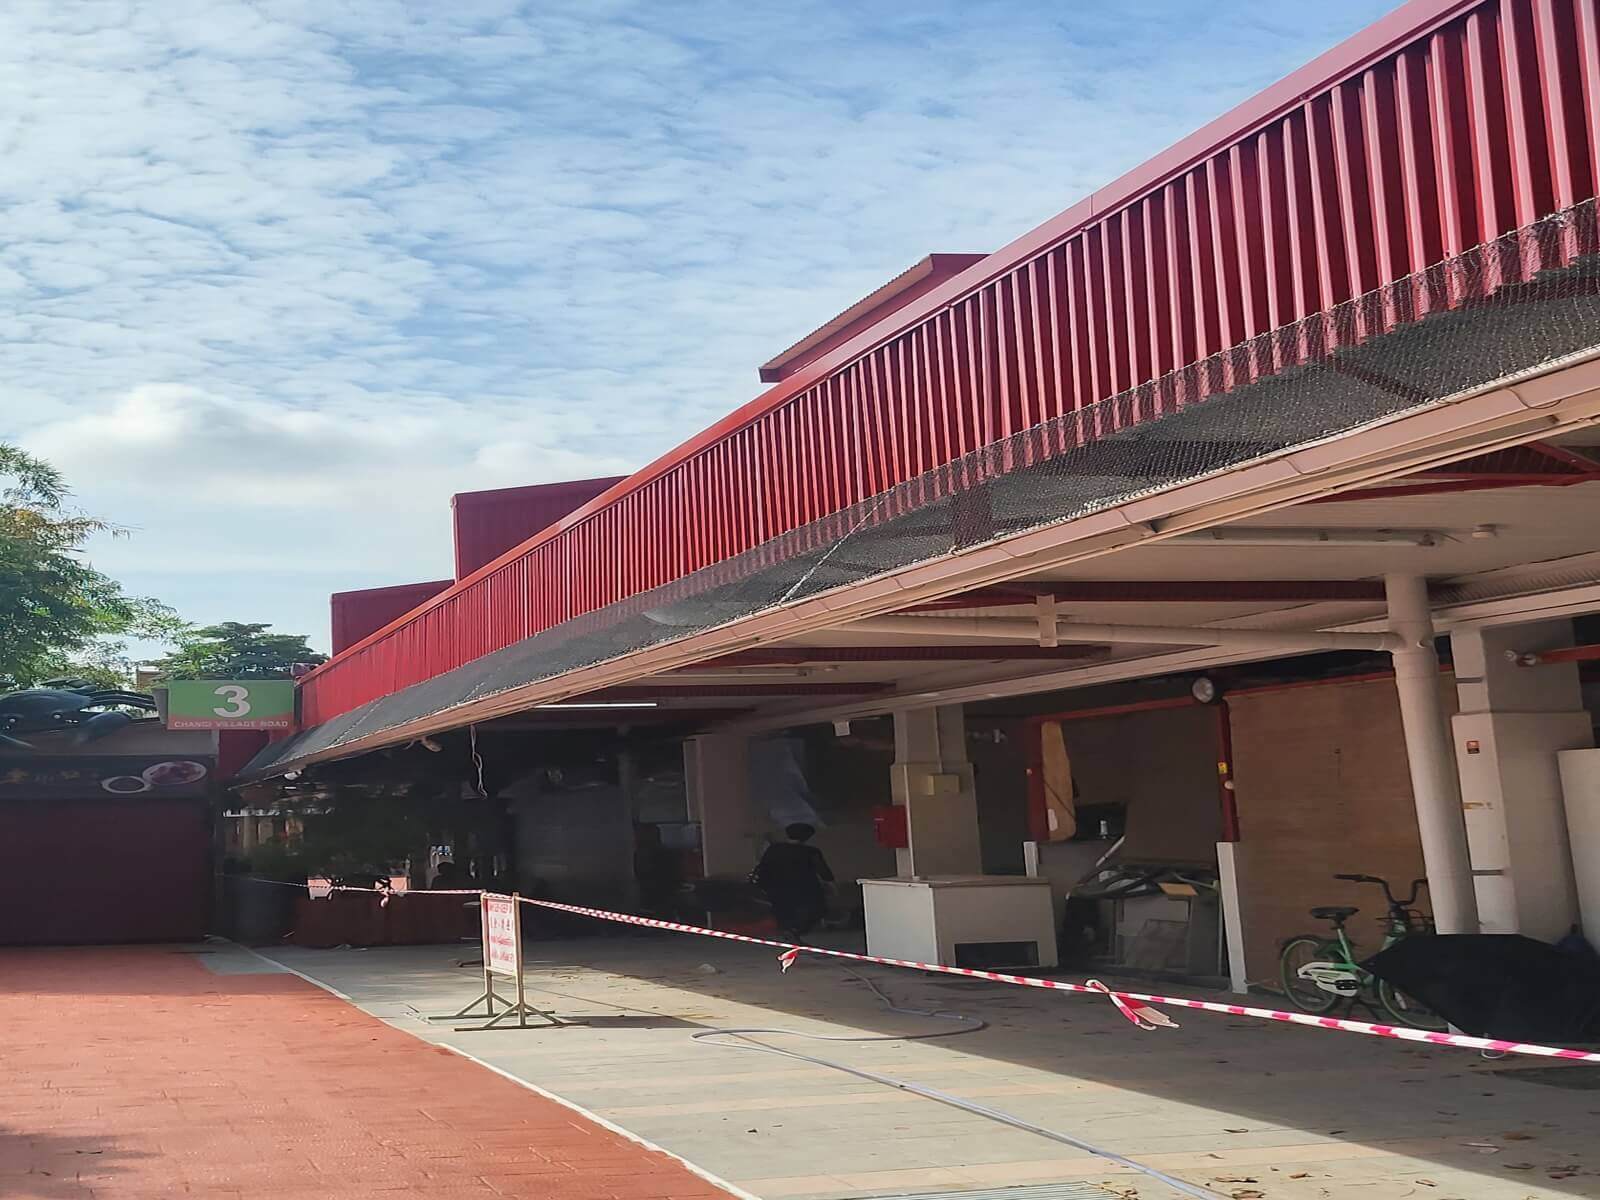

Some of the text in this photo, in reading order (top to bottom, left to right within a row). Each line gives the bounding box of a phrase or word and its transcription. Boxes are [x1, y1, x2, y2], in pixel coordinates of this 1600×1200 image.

[213, 685, 251, 718] 3
[174, 720, 288, 728] CHANGI VILLAGE ROAD
